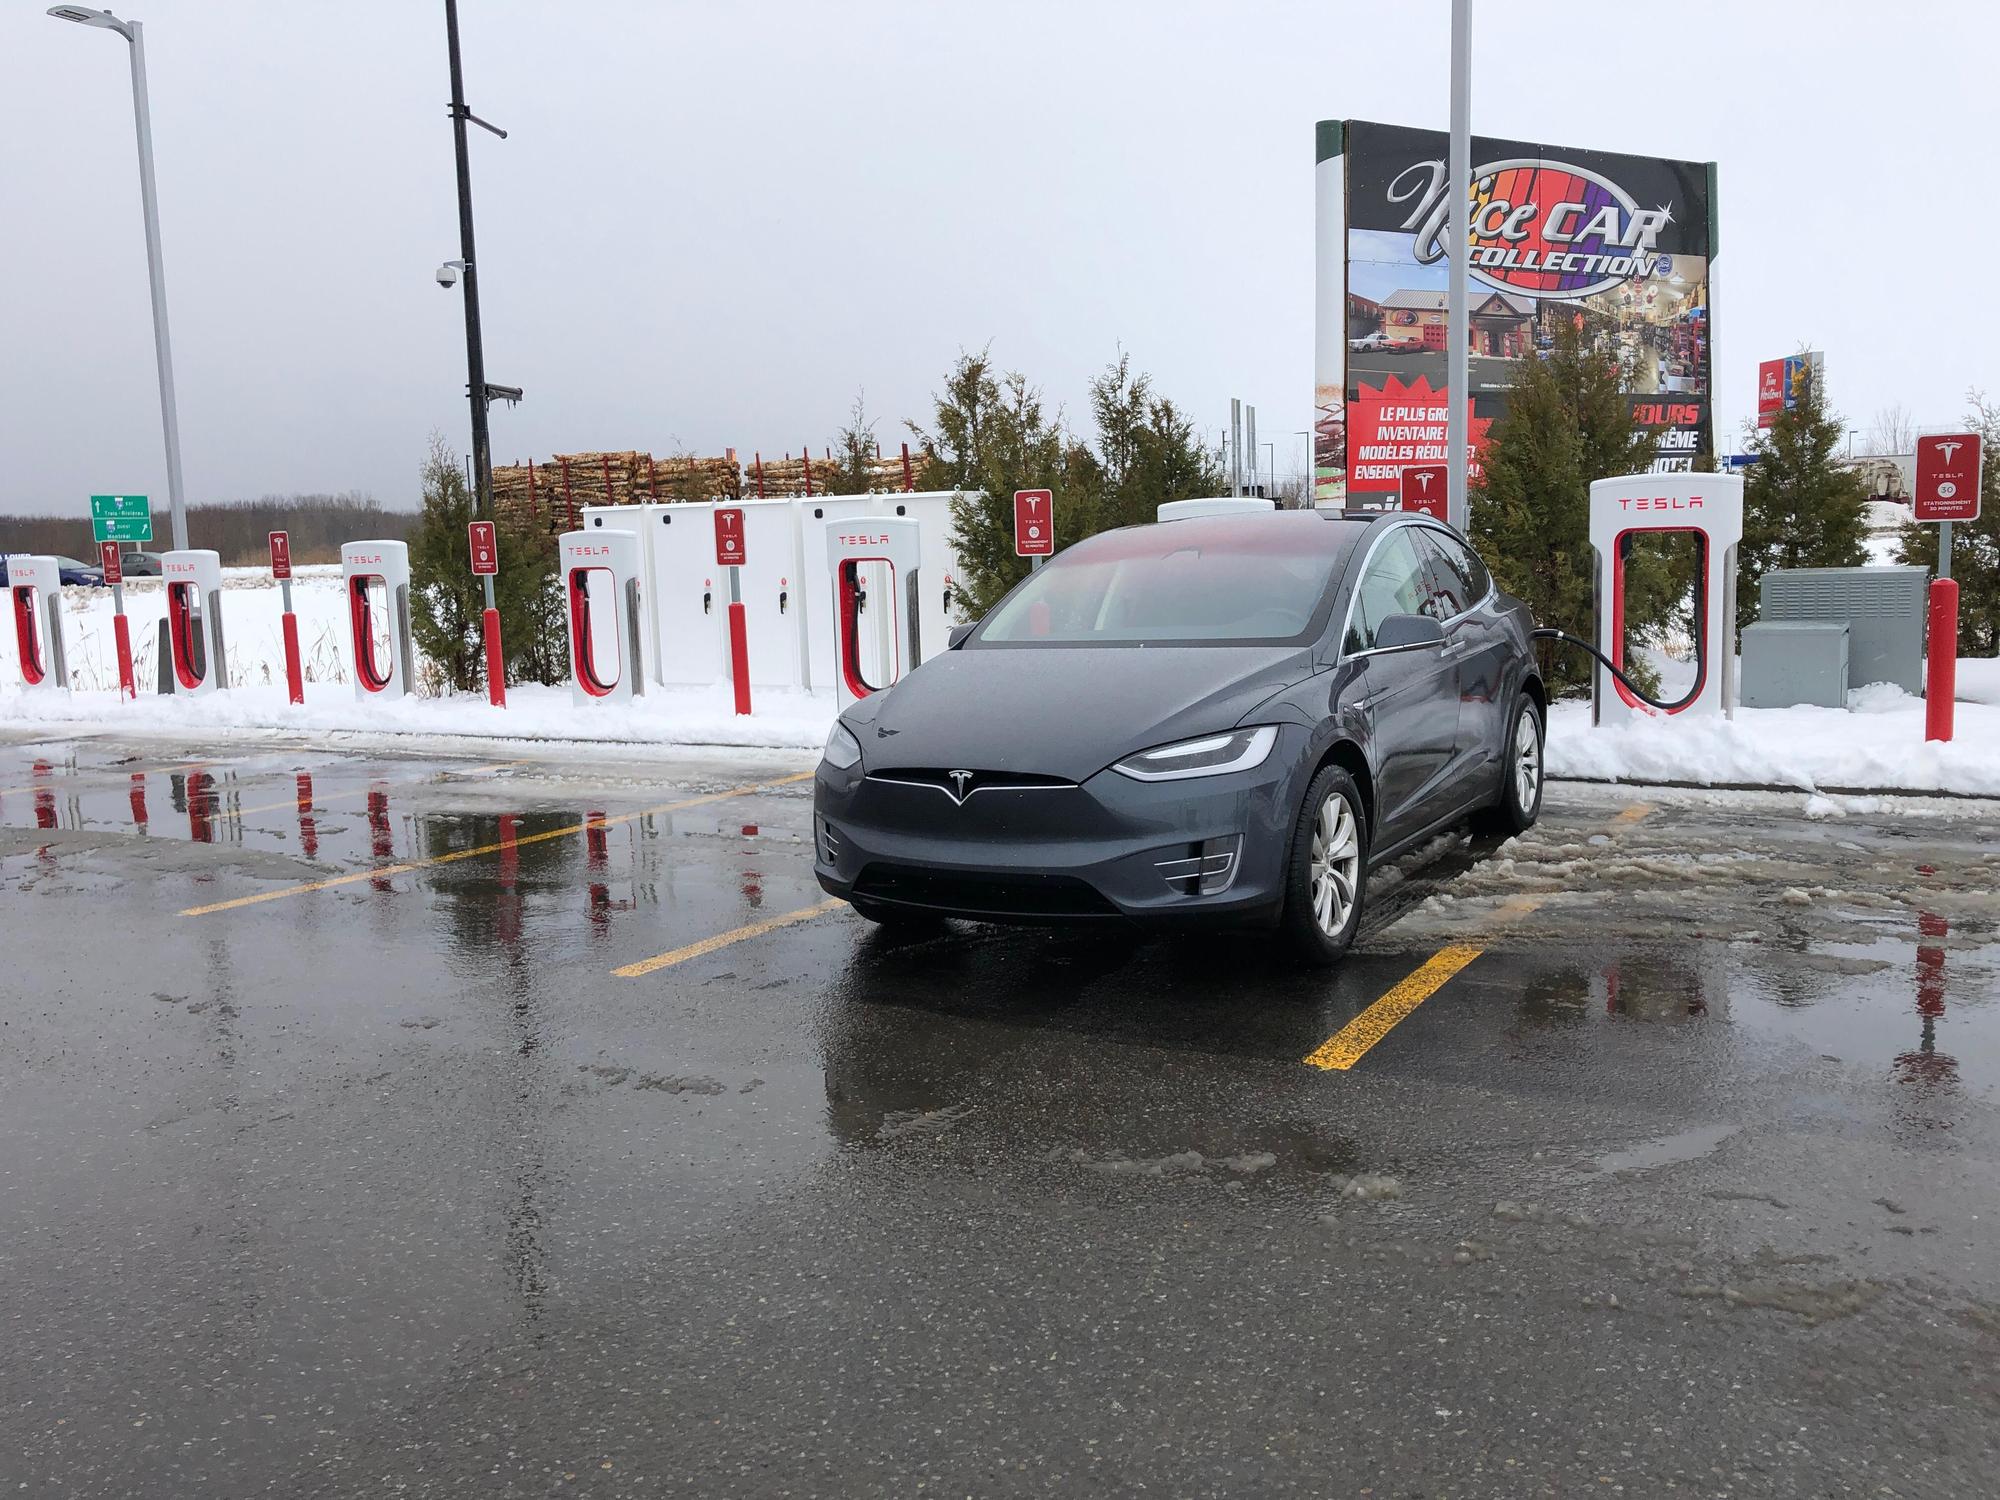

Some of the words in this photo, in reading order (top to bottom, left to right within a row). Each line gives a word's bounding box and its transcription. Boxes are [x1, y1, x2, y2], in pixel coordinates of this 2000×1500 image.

[1542, 202, 1668, 249] CAR
[1468, 244, 1656, 278] COLLECTION
[1380, 407, 1394, 421] LE
[1395, 407, 1426, 421] PLUS
[1427, 407, 1448, 421] GRO
[1377, 426, 1445, 441] INVENTAIRE
[1358, 442, 1414, 460] MODÈLES
[1415, 442, 1448, 460] RÉDUI
[1941, 486, 1954, 494] 30
[1619, 496, 1703, 510] TESLA
[838, 534, 889, 545] TESLA
[568, 546, 609, 556] TESLA
[347, 555, 382, 565] TESLA
[167, 563, 195, 572] TESLA
